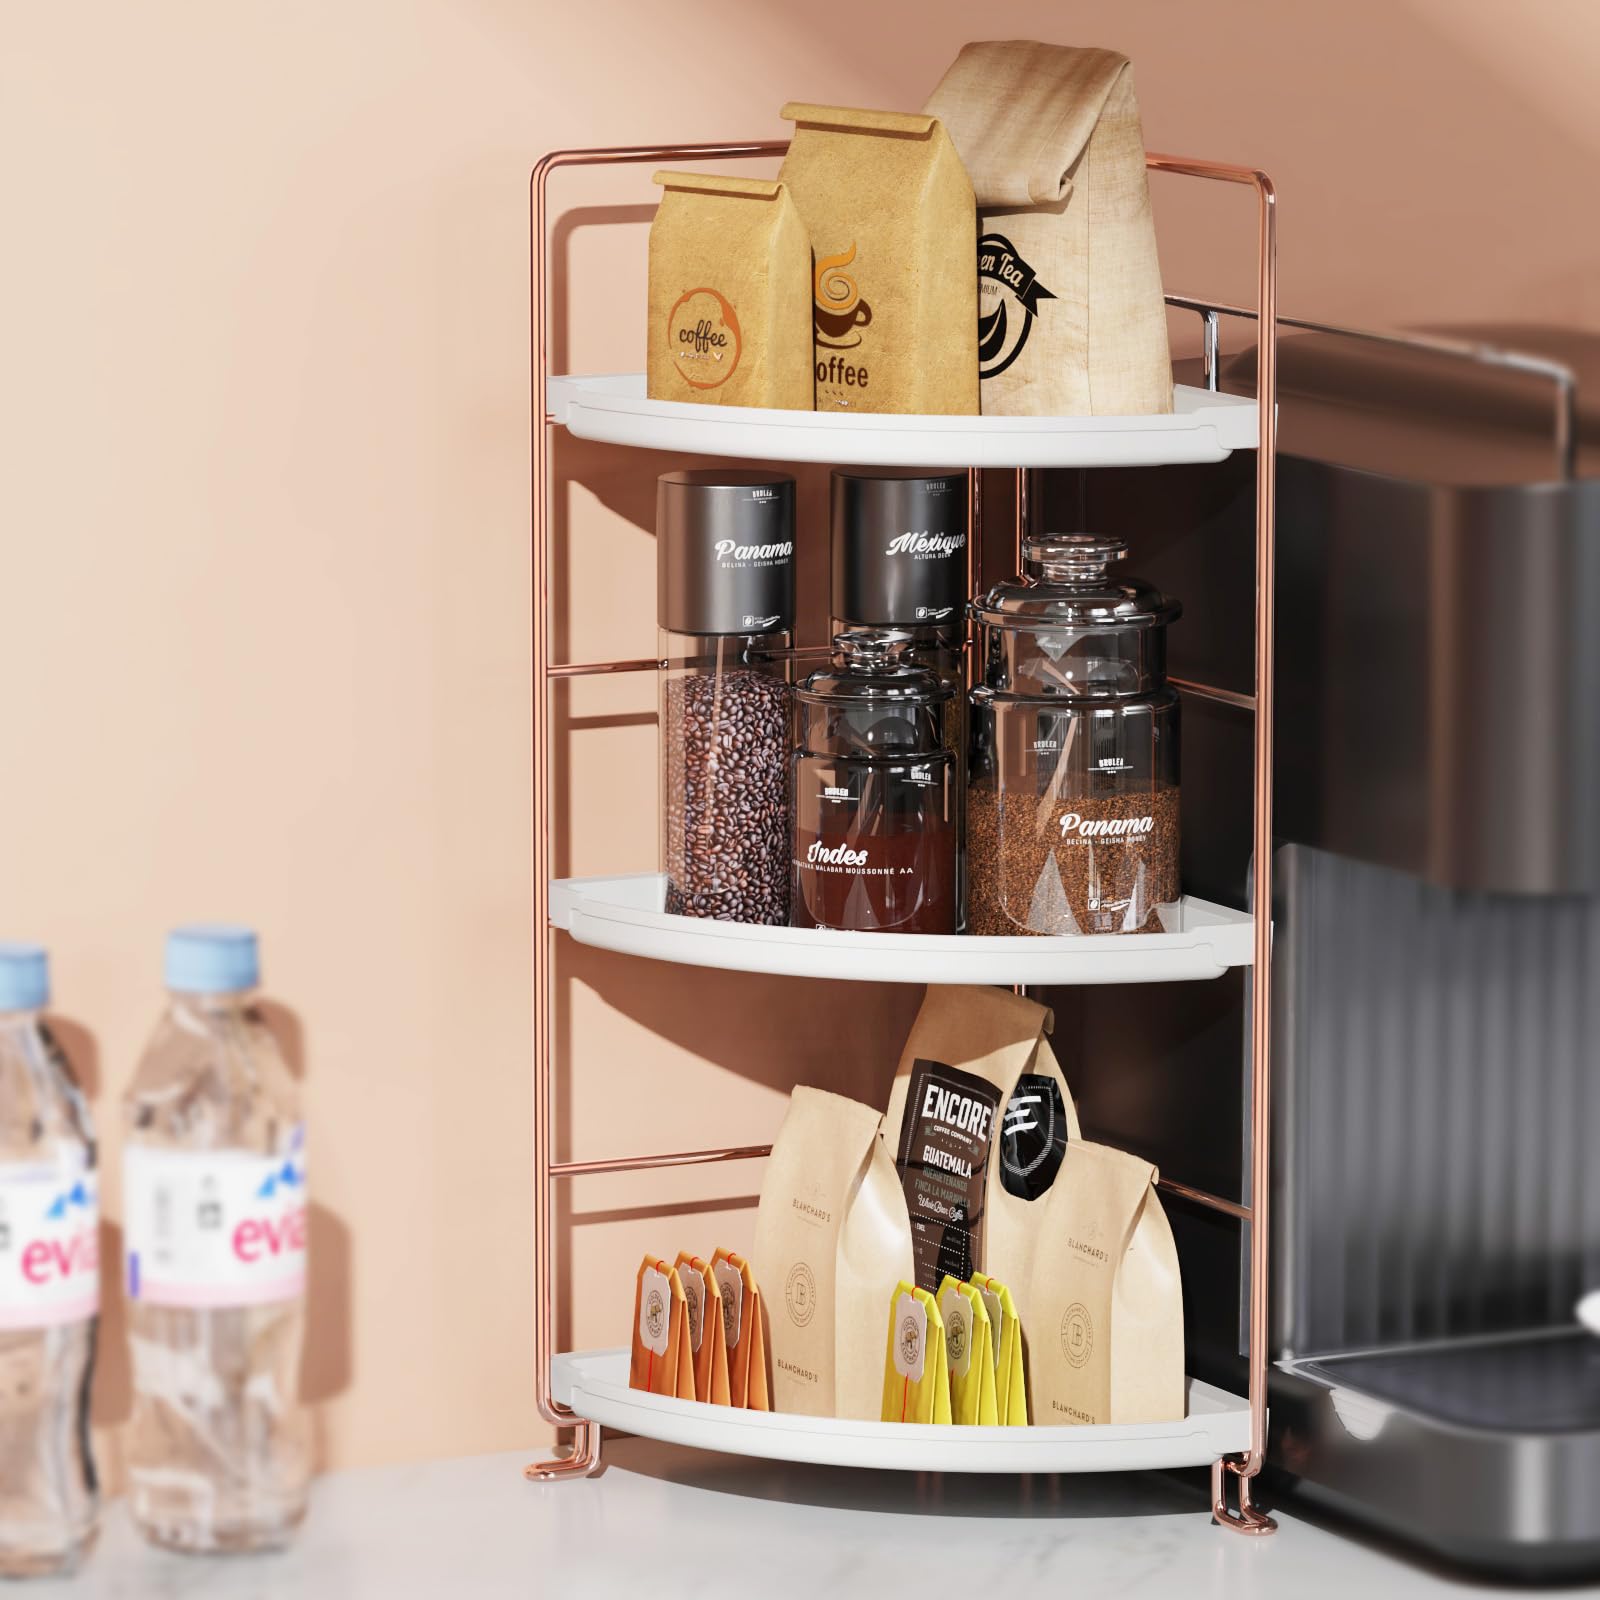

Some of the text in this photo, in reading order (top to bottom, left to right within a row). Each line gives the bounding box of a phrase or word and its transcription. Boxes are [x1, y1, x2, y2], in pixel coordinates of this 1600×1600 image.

[998, 253, 1024, 287] Tea
[679, 319, 728, 353] coffee
[817, 356, 869, 387] offee
[714, 539, 793, 561] Panama
[885, 530, 966, 556] Méxique
[1059, 813, 1154, 837] Panama
[807, 840, 869, 866] Indes
[815, 864, 843, 873] MALABAR
[921, 1083, 992, 1142] ENCORE
[933, 1124, 951, 1135] COFFEE
[922, 1144, 972, 1179] GUATEMALA
[777, 1359, 818, 1383] BLANCHARD'S
[1052, 1400, 1096, 1425] BLANCHARD'S
